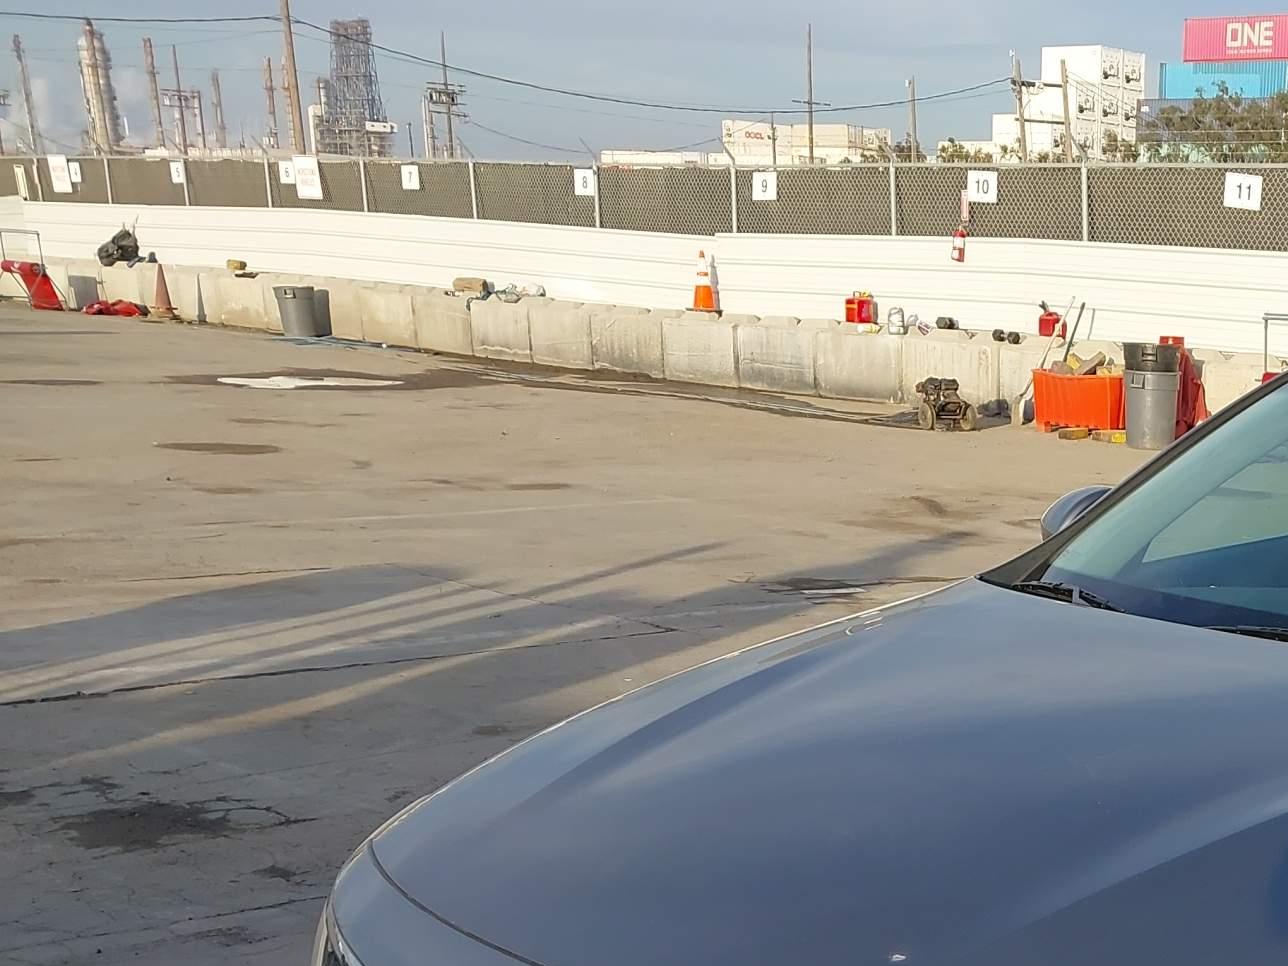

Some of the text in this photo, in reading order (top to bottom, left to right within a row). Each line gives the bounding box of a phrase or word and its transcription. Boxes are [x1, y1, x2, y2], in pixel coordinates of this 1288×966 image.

[1226, 21, 1274, 47] ONE
[582, 175, 588, 189] 8
[761, 178, 768, 193] 9
[975, 179, 990, 194] 10
[1236, 182, 1252, 201] 11
